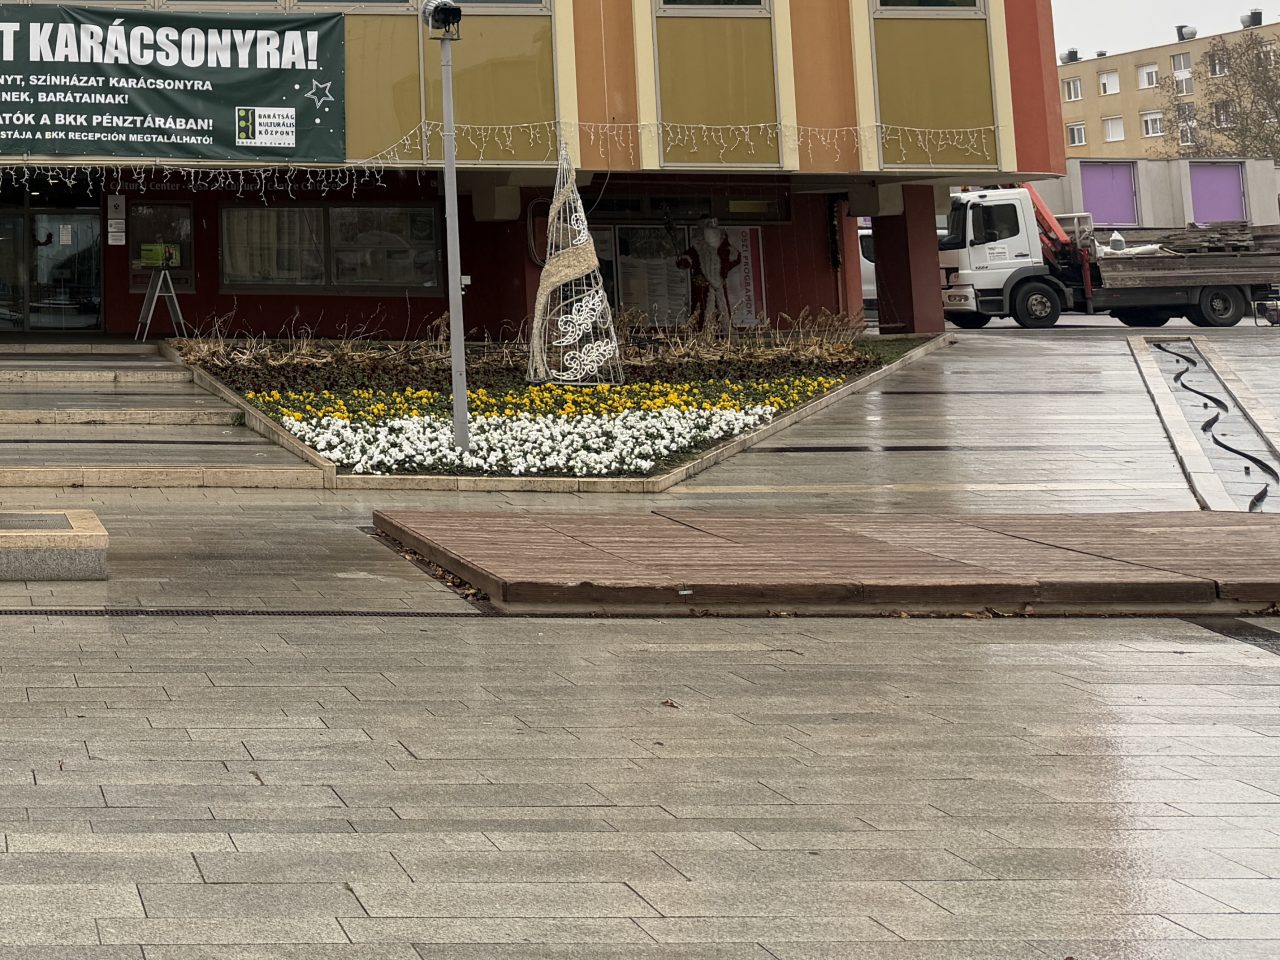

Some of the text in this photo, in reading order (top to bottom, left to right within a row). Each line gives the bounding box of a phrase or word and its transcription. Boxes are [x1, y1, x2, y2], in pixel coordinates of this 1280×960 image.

[29, 18, 319, 70] KARÁCSONYRA!
[29, 73, 105, 87] SZÍNHÁZAT
[109, 76, 212, 90] KARÁCSONYRA
[37, 91, 129, 104] BARÁTAINAK!
[39, 114, 51, 125] A
[55, 114, 87, 126] BKK
[92, 113, 213, 130] PÉNZTÁRÁBAN!
[35, 131, 42, 139] A
[45, 131, 66, 140] BKK
[68, 130, 126, 141] RECEPCIÓN
[129, 133, 213, 145] MEGTALÁLHATÓ!
[149, 181, 181, 191] Center
